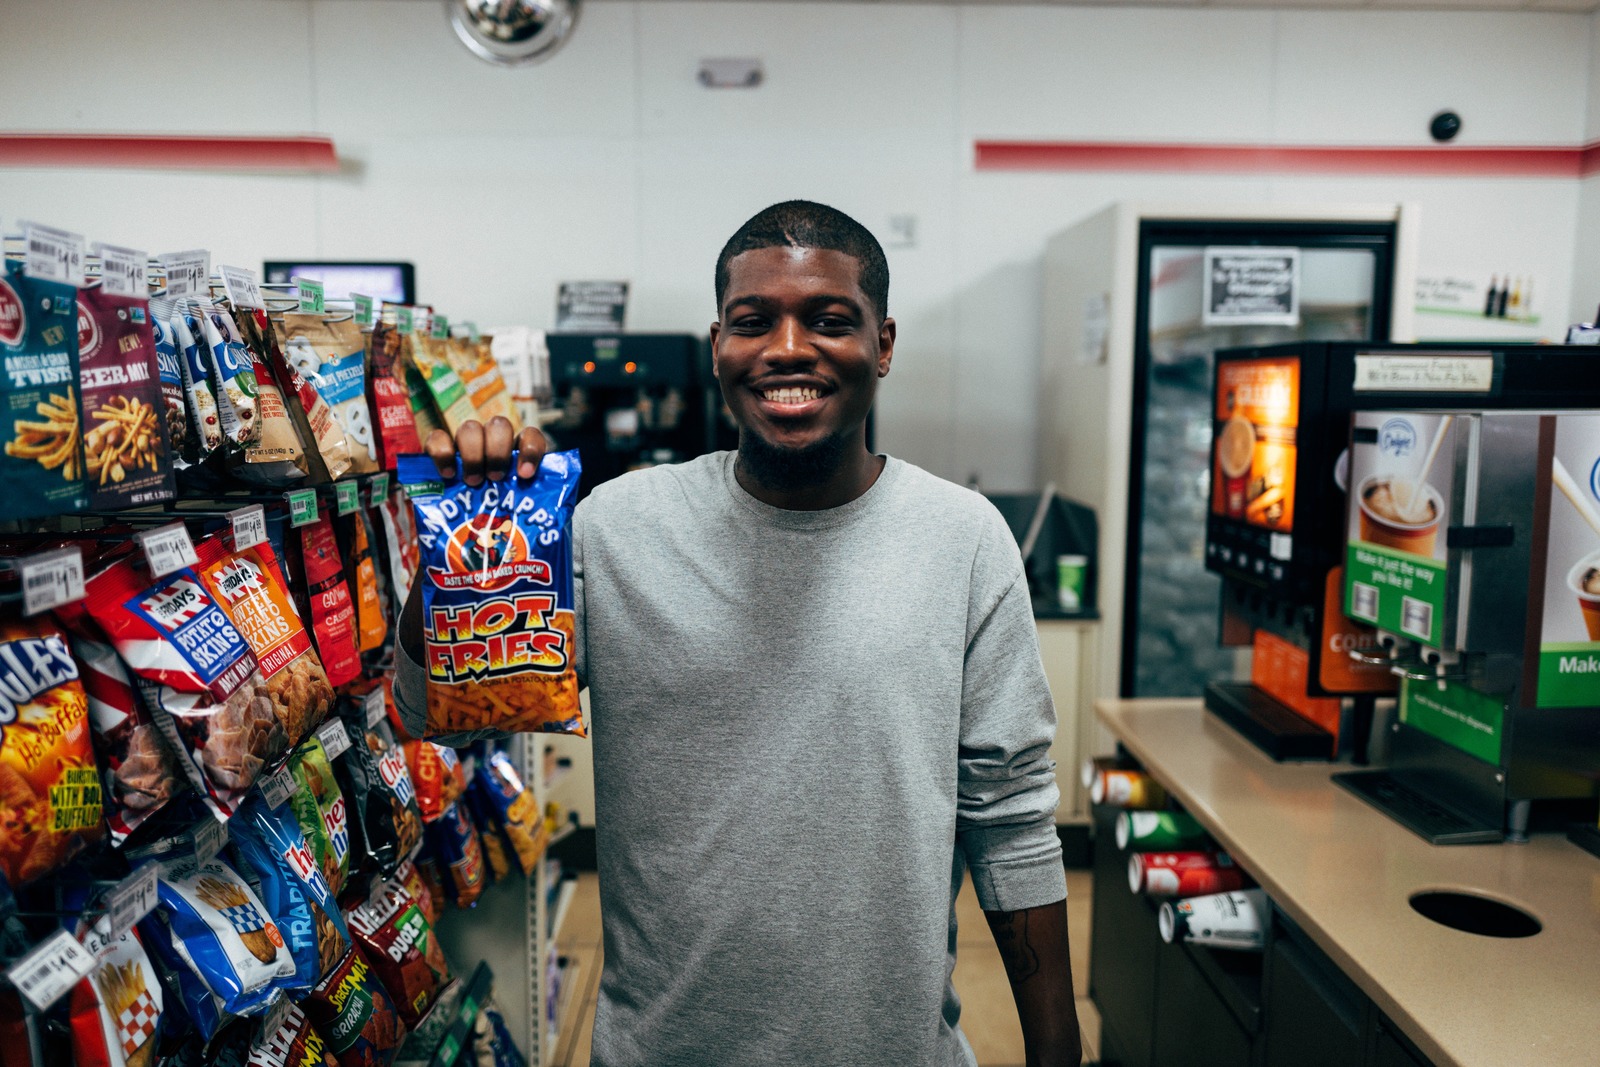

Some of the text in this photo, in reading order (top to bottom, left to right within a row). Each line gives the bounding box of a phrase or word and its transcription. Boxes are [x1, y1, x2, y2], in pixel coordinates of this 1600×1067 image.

[118, 333, 143, 354] NEW!
[127, 361, 150, 382] MIX
[418, 488, 472, 549] ANDY
[444, 575, 463, 587] TASTE
[463, 574, 474, 584] THE
[514, 564, 545, 575] CRUNCH!
[1400, 561, 1414, 576] the
[1415, 567, 1435, 585] way
[176, 611, 226, 653] POTATO
[433, 597, 552, 641] HOT
[190, 625, 240, 669] SKINS
[261, 642, 298, 674] ORIGINAL
[427, 632, 564, 677] FRIES
[51, 786, 79, 807] WITH
[387, 921, 421, 963] DUOZ
[332, 994, 365, 1040] SRIRACHA
